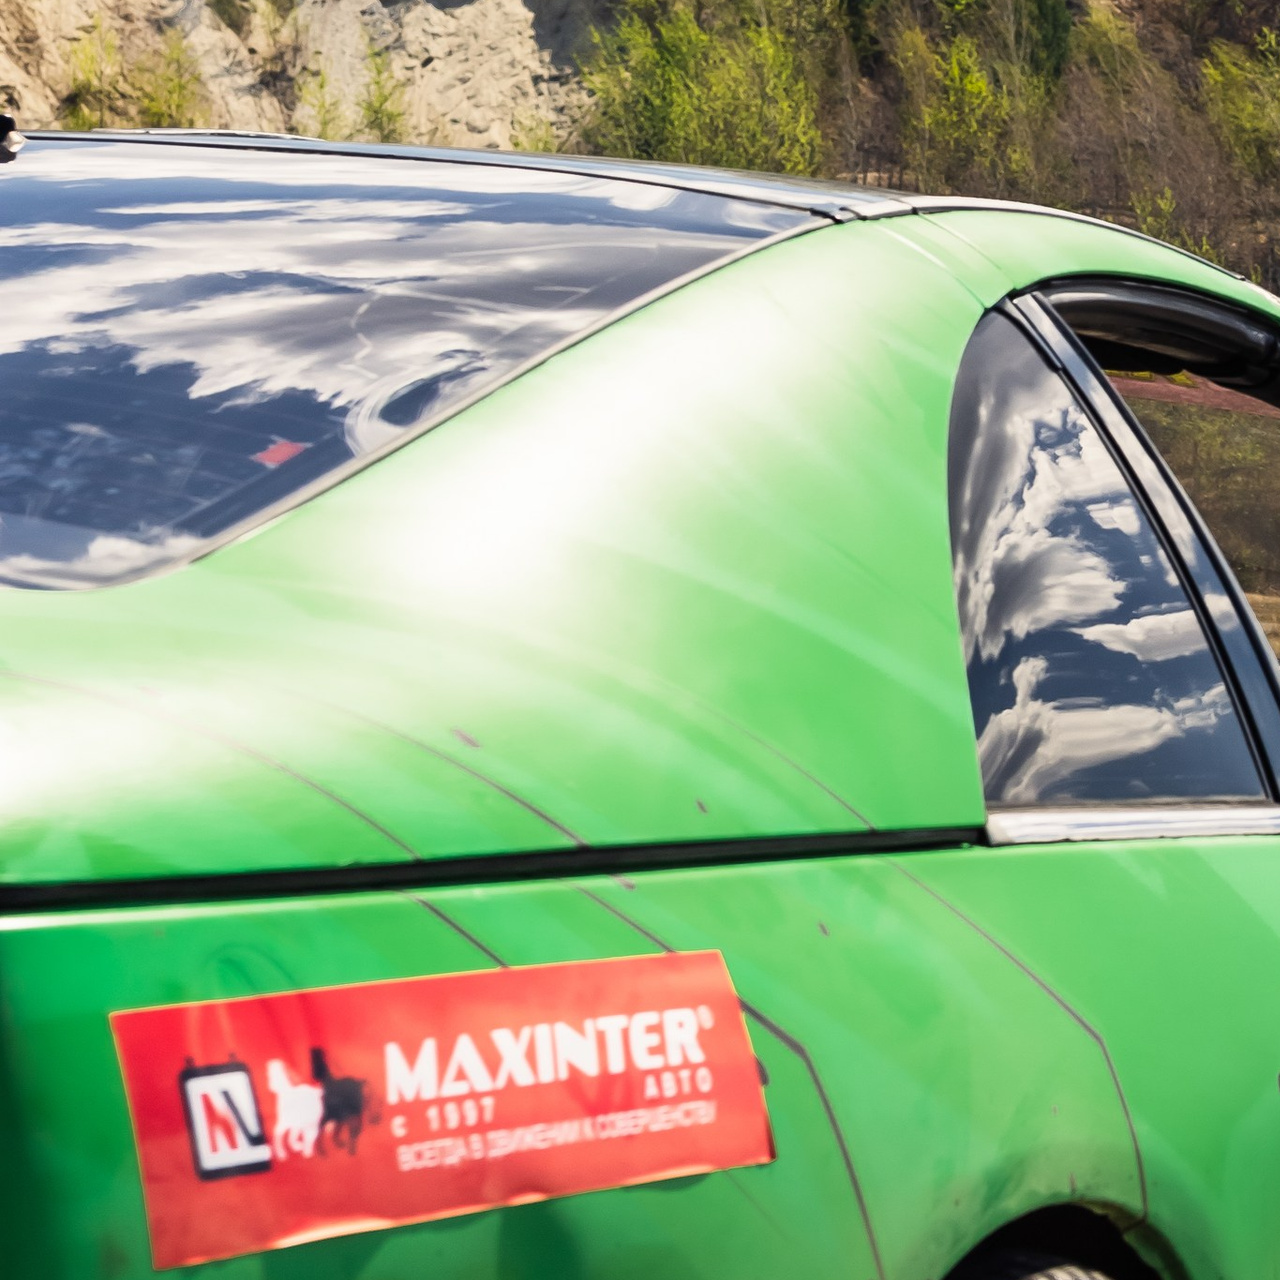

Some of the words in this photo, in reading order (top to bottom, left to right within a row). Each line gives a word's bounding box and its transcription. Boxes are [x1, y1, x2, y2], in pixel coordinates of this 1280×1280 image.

[384, 1007, 706, 1106] MAXINTER
[644, 1067, 713, 1100] АВТО
[426, 1096, 495, 1131] 1997
